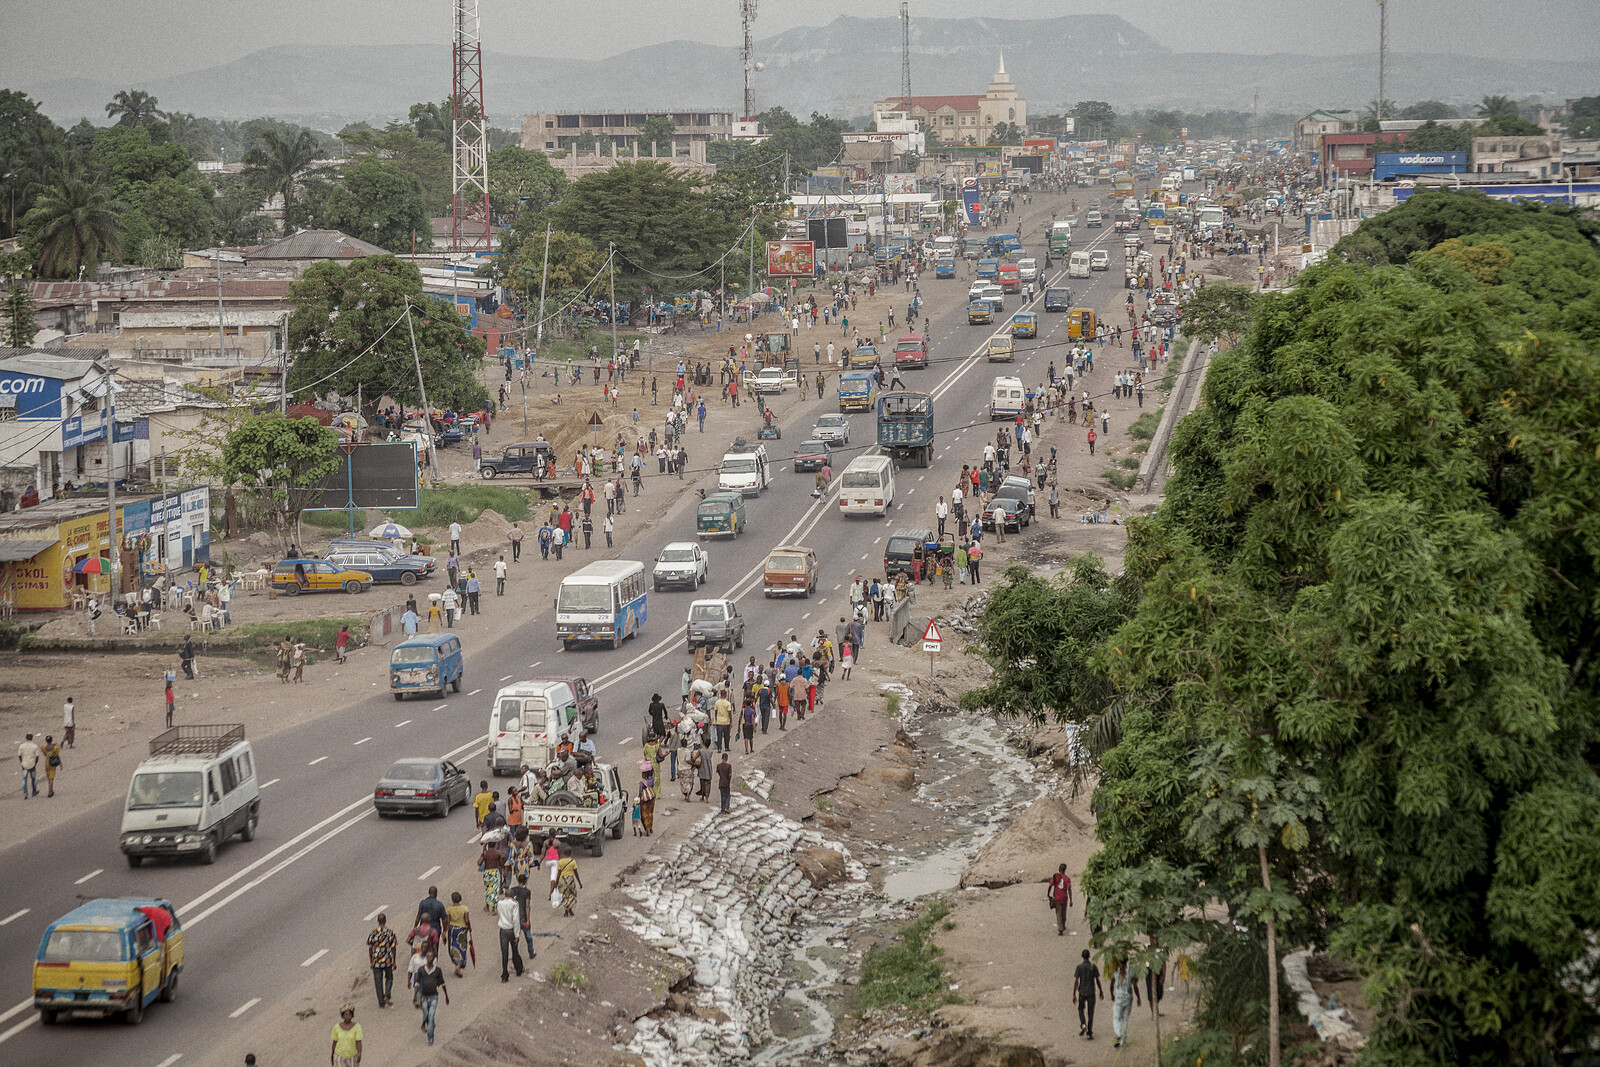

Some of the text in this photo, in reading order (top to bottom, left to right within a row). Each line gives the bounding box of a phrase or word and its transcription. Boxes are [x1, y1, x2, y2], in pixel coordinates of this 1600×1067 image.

[1399, 153, 1445, 164] vodacom
[0, 377, 45, 394] com
[16, 567, 49, 579] SKOL
[538, 814, 583, 824] TOYOTA
